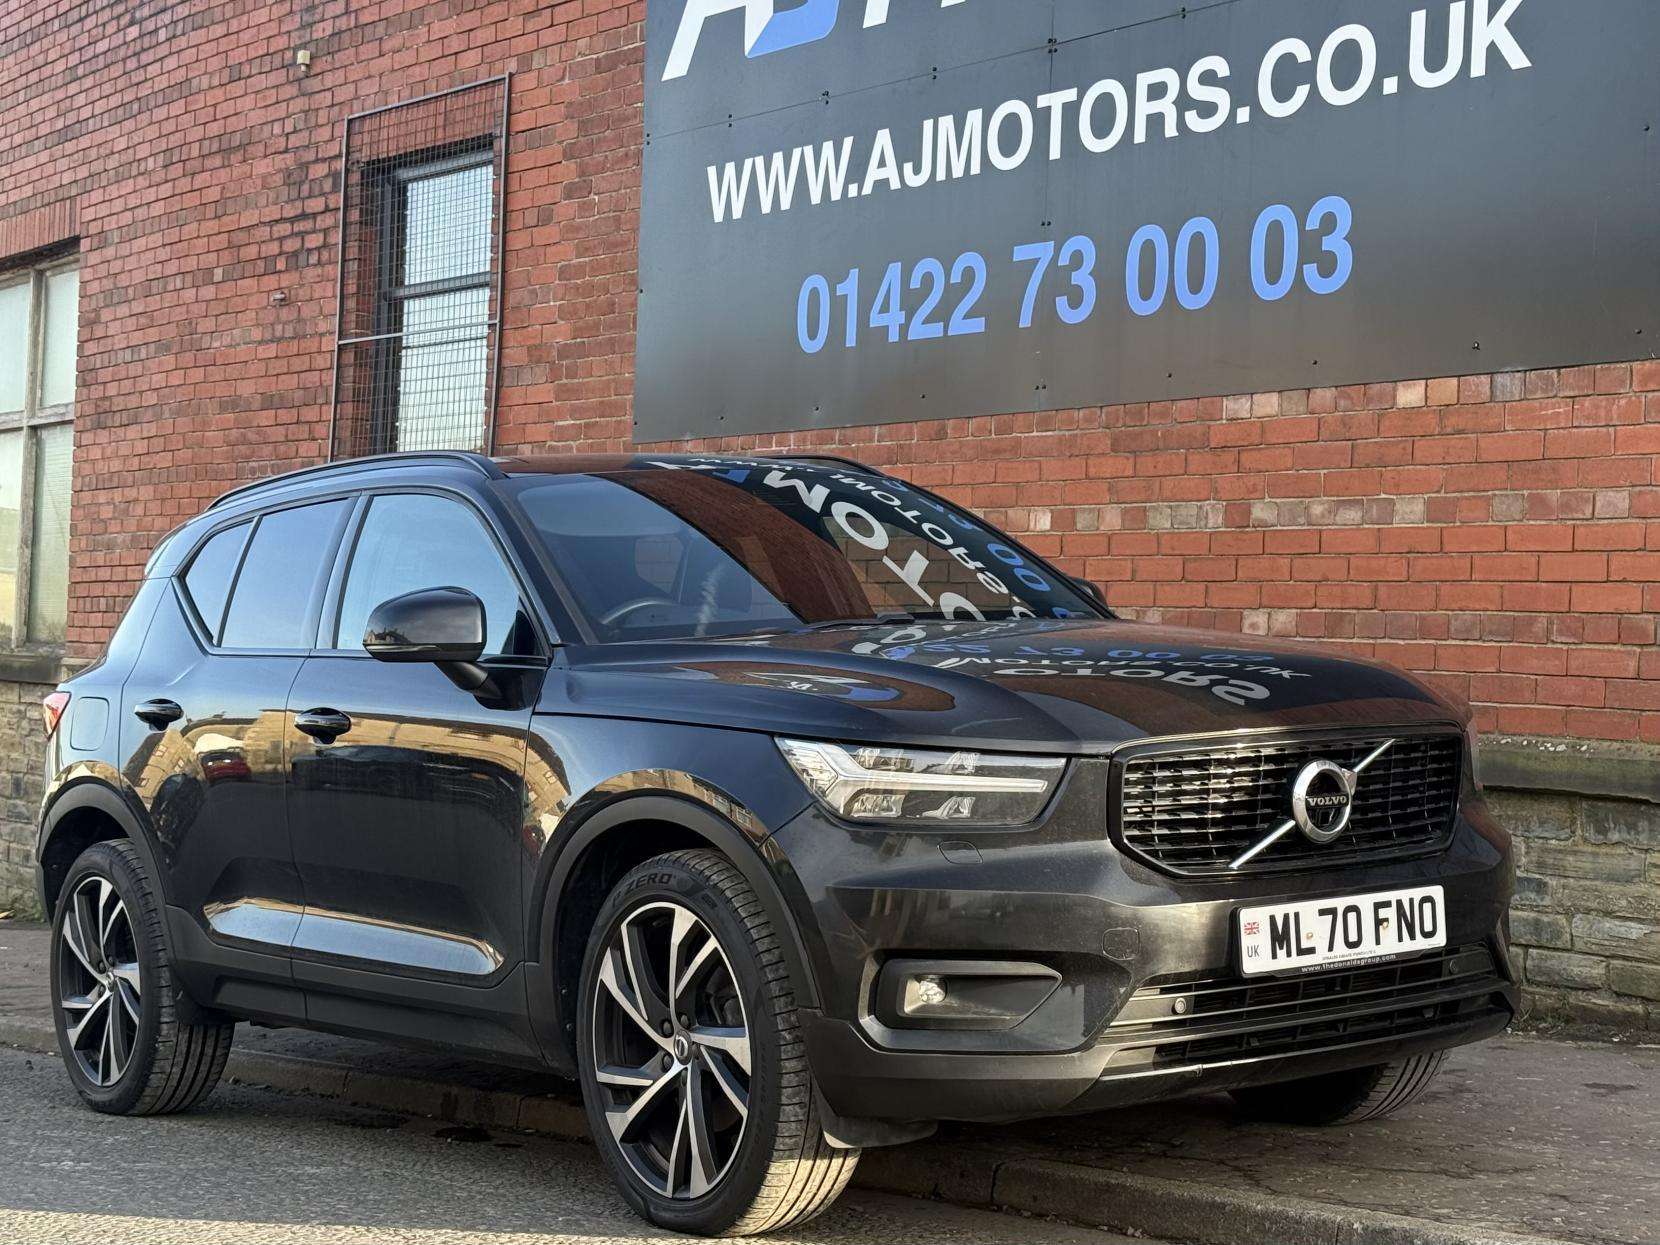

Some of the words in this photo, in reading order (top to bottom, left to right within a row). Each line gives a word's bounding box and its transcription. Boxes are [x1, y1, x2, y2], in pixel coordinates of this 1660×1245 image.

[706, 0, 1532, 223] WWW.AJMOTORS.CO.UK
[797, 251, 987, 354] 01422
[1012, 235, 1097, 328] 73
[1125, 216, 1220, 316] 00
[1250, 195, 1354, 301] 03
[1307, 795, 1347, 806] VOLVO
[626, 873, 669, 892] ZERO
[1373, 895, 1438, 946] FNO
[1247, 945, 1260, 958] UK
